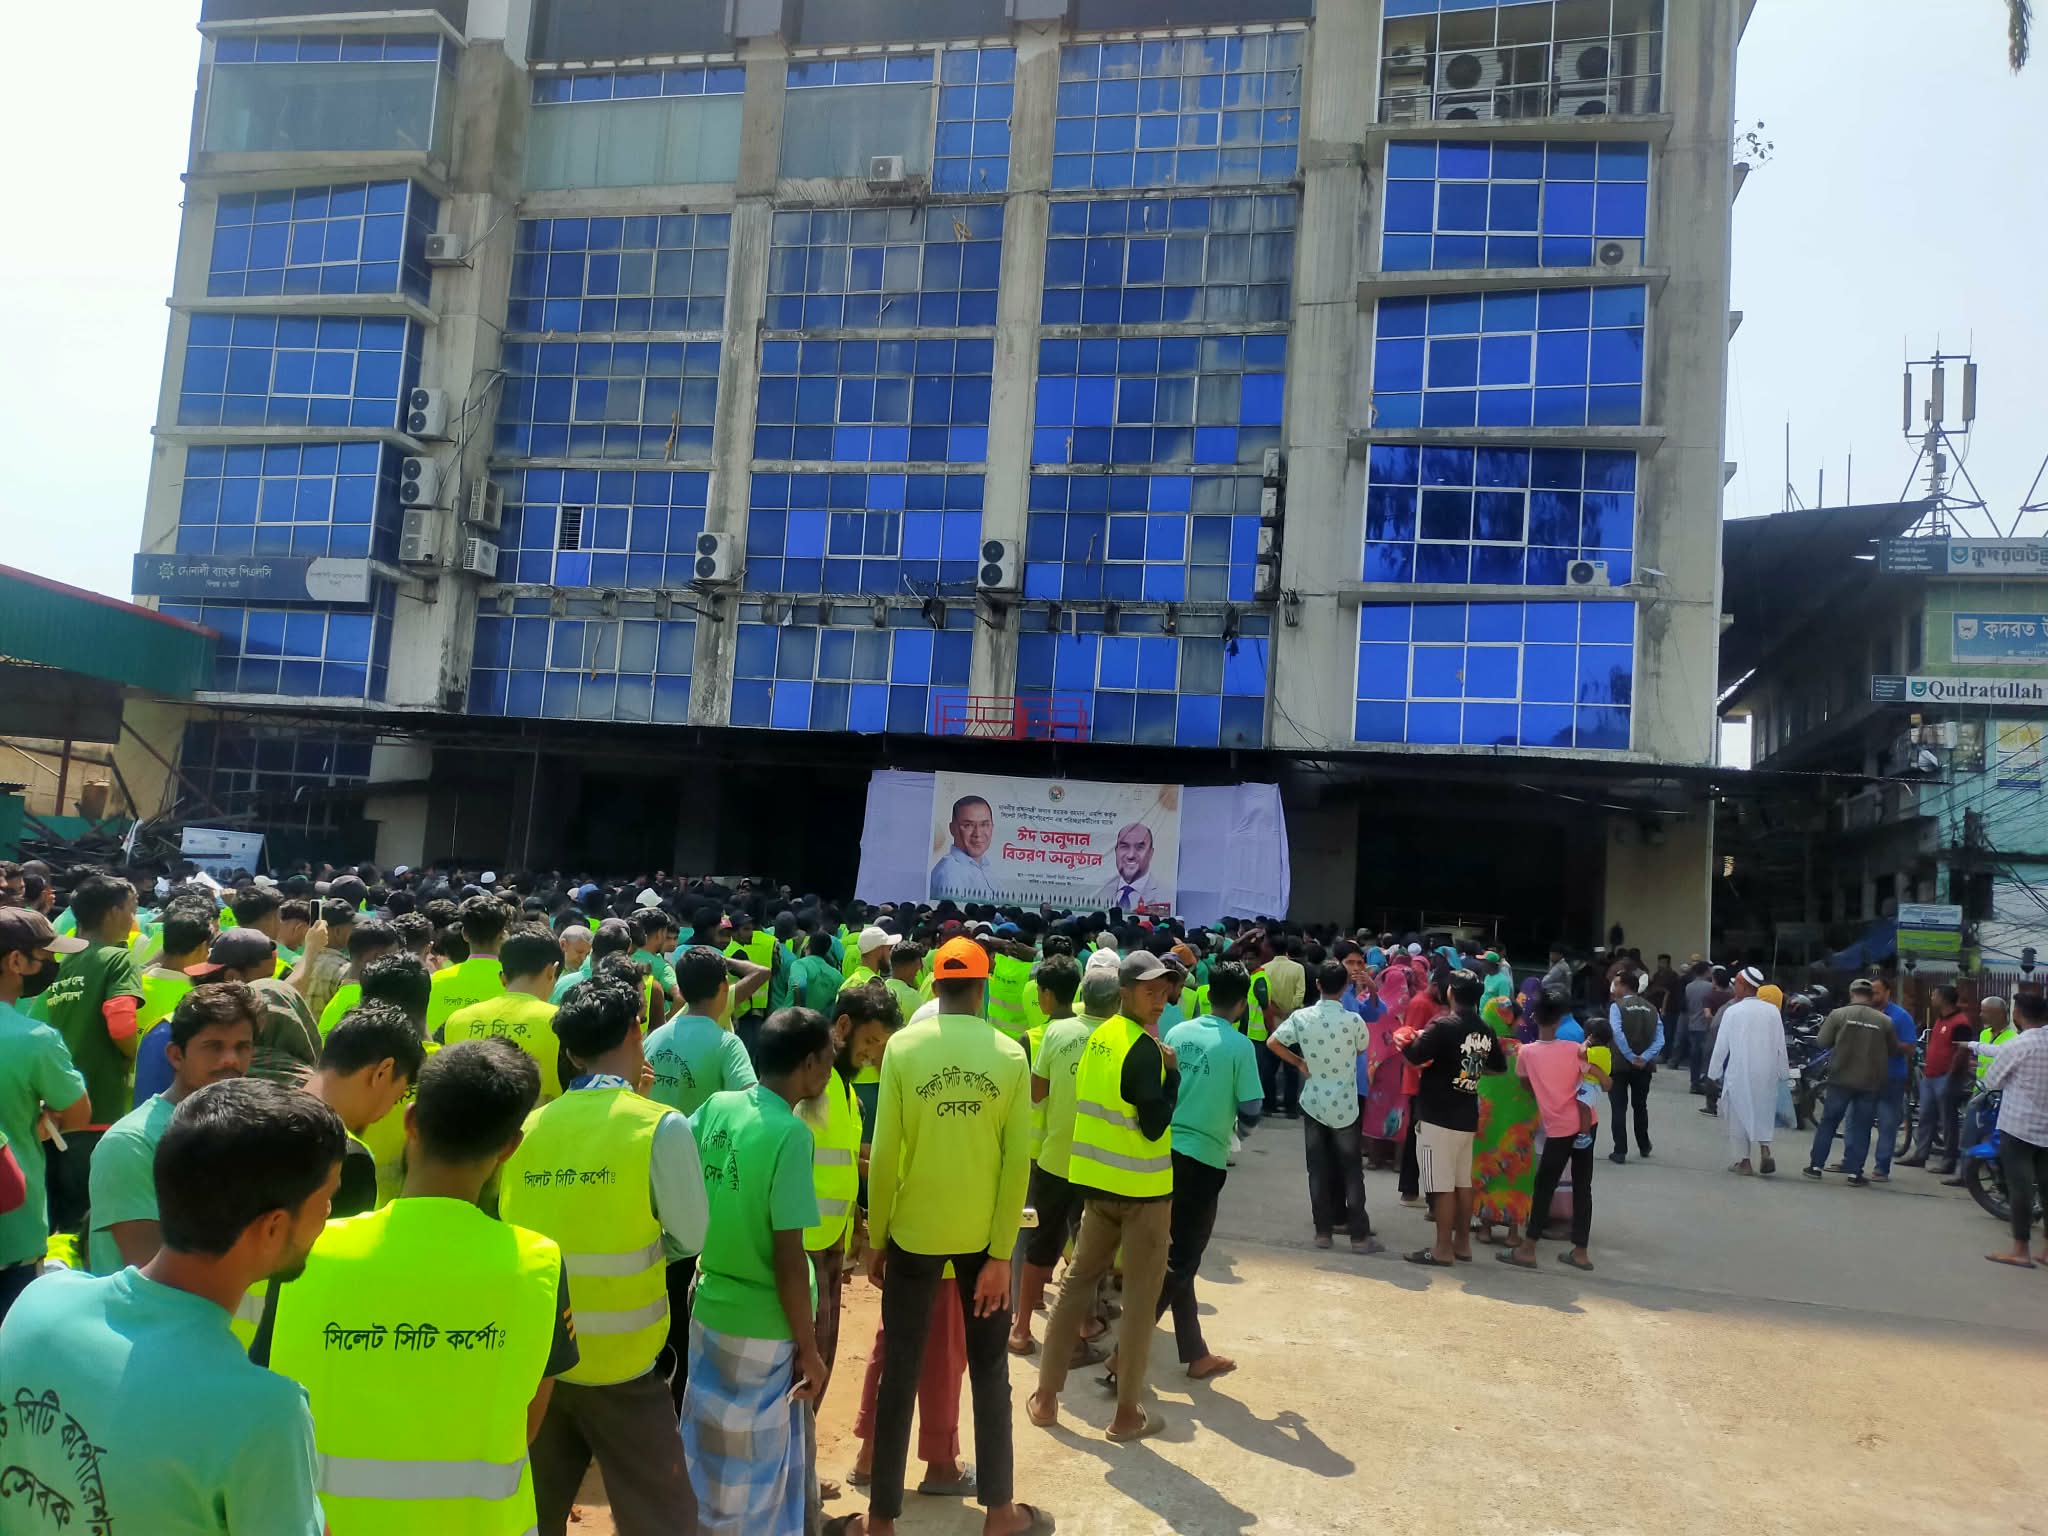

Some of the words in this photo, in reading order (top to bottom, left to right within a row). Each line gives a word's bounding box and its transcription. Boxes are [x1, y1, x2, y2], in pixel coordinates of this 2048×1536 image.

[1929, 681, 2043, 700] Qudratullah
[1017, 826, 1037, 841] ঈদ
[1039, 831, 1090, 849] অনুদান
[1003, 842, 1046, 862] বিতরণ
[1048, 848, 1103, 869] অনুষ্ঠান
[916, 1073, 943, 1103] সিলেট
[942, 1065, 961, 1089] সিটি
[962, 1070, 1001, 1101] কর্পোরেশন
[937, 1100, 983, 1117] সেবক
[524, 1169, 553, 1189] সিলেট
[555, 1168, 578, 1188] সিটি
[322, 1321, 389, 1351] সিলেট
[393, 1322, 440, 1351] সিটি
[445, 1320, 506, 1350] কর্পোঃ
[13, 1387, 61, 1435] সিটি
[1, 1465, 75, 1532] সেবক
